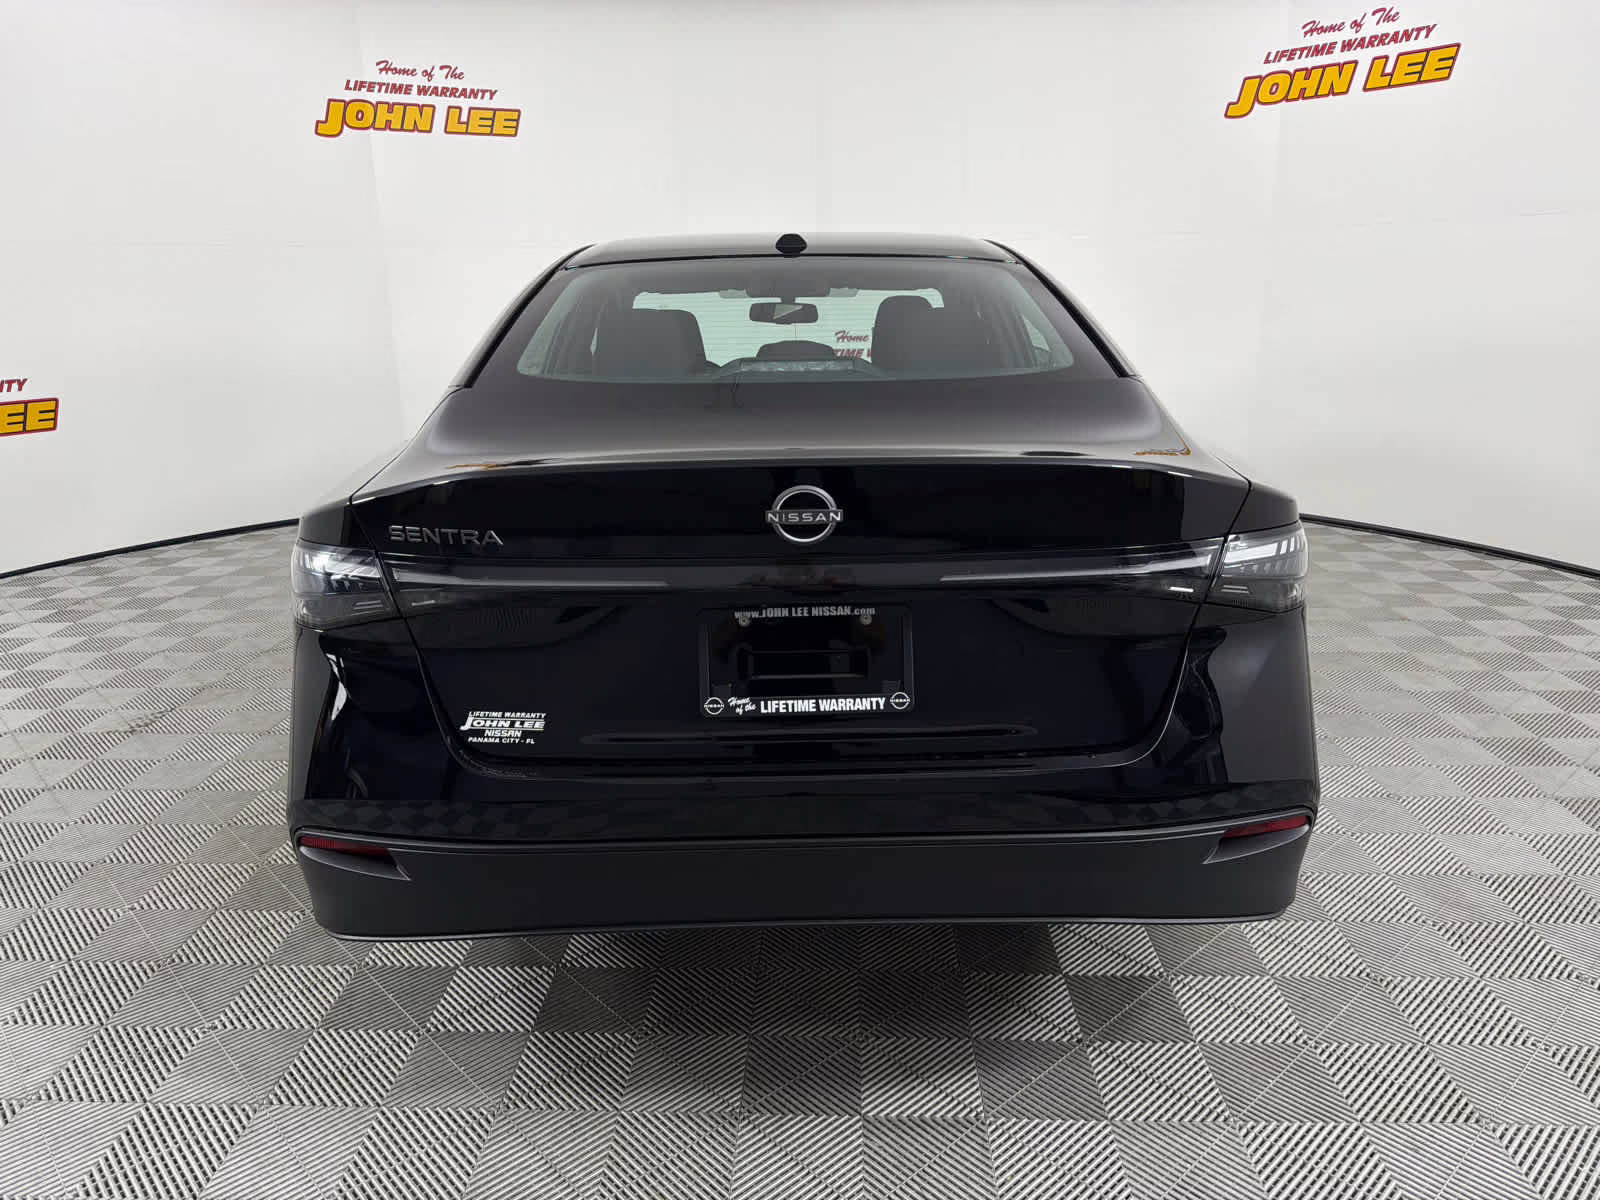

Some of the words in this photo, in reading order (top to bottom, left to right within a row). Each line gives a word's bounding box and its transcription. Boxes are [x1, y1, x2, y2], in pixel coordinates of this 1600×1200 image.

[1302, 20, 1345, 38] Home
[1350, 12, 1366, 34] of
[1371, 6, 1400, 26] The
[1264, 41, 1337, 64] LIFETIME
[1340, 23, 1437, 54] WARRANTY
[376, 59, 417, 77] Home
[421, 65, 435, 82] of
[439, 65, 465, 80] The
[1224, 59, 1358, 119] JOHN
[1362, 42, 1461, 92] LEE
[344, 79, 413, 96] LIFETIME
[416, 85, 498, 101] WARRANTY
[315, 98, 436, 138] JOHN
[444, 105, 521, 137] LEE
[835, 329, 869, 343] Home
[834, 348, 864, 359] TIME
[0, 397, 59, 437] EE
[766, 510, 842, 523] NISSAN
[388, 525, 504, 546] SENTRA
[791, 606, 809, 617] LEE
[760, 699, 816, 714] LIFETIME
[819, 697, 886, 712] WARRANTY
[460, 717, 511, 731] JOHN
[514, 720, 545, 729] LEE
